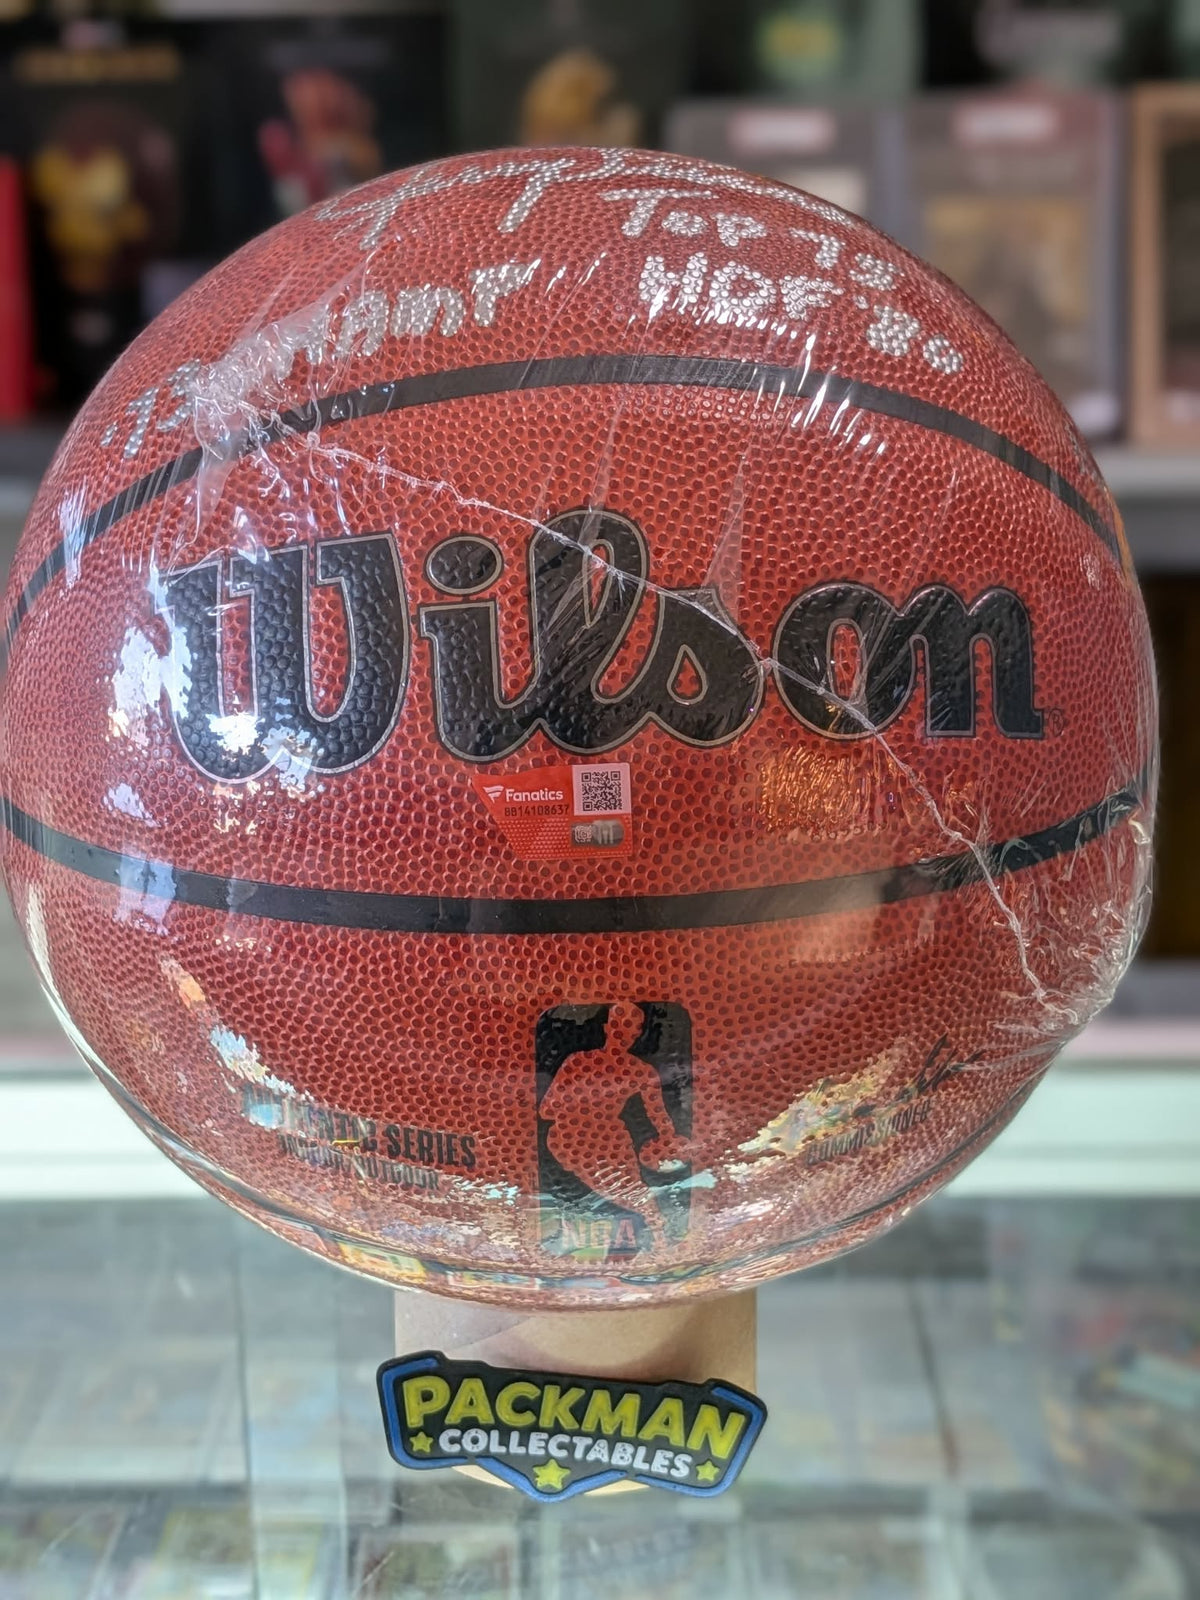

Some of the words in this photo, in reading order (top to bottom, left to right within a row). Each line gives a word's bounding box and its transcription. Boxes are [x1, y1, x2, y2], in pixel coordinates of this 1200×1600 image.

[637, 250, 845, 322] HOF
[155, 510, 1046, 786] Wilson
[505, 787, 564, 803] Fanatics
[387, 1122, 477, 1170] SERIES
[561, 1216, 638, 1250] NBA
[402, 1375, 746, 1460] PACKMAN
[438, 1428, 693, 1479] COLLECTABLES
